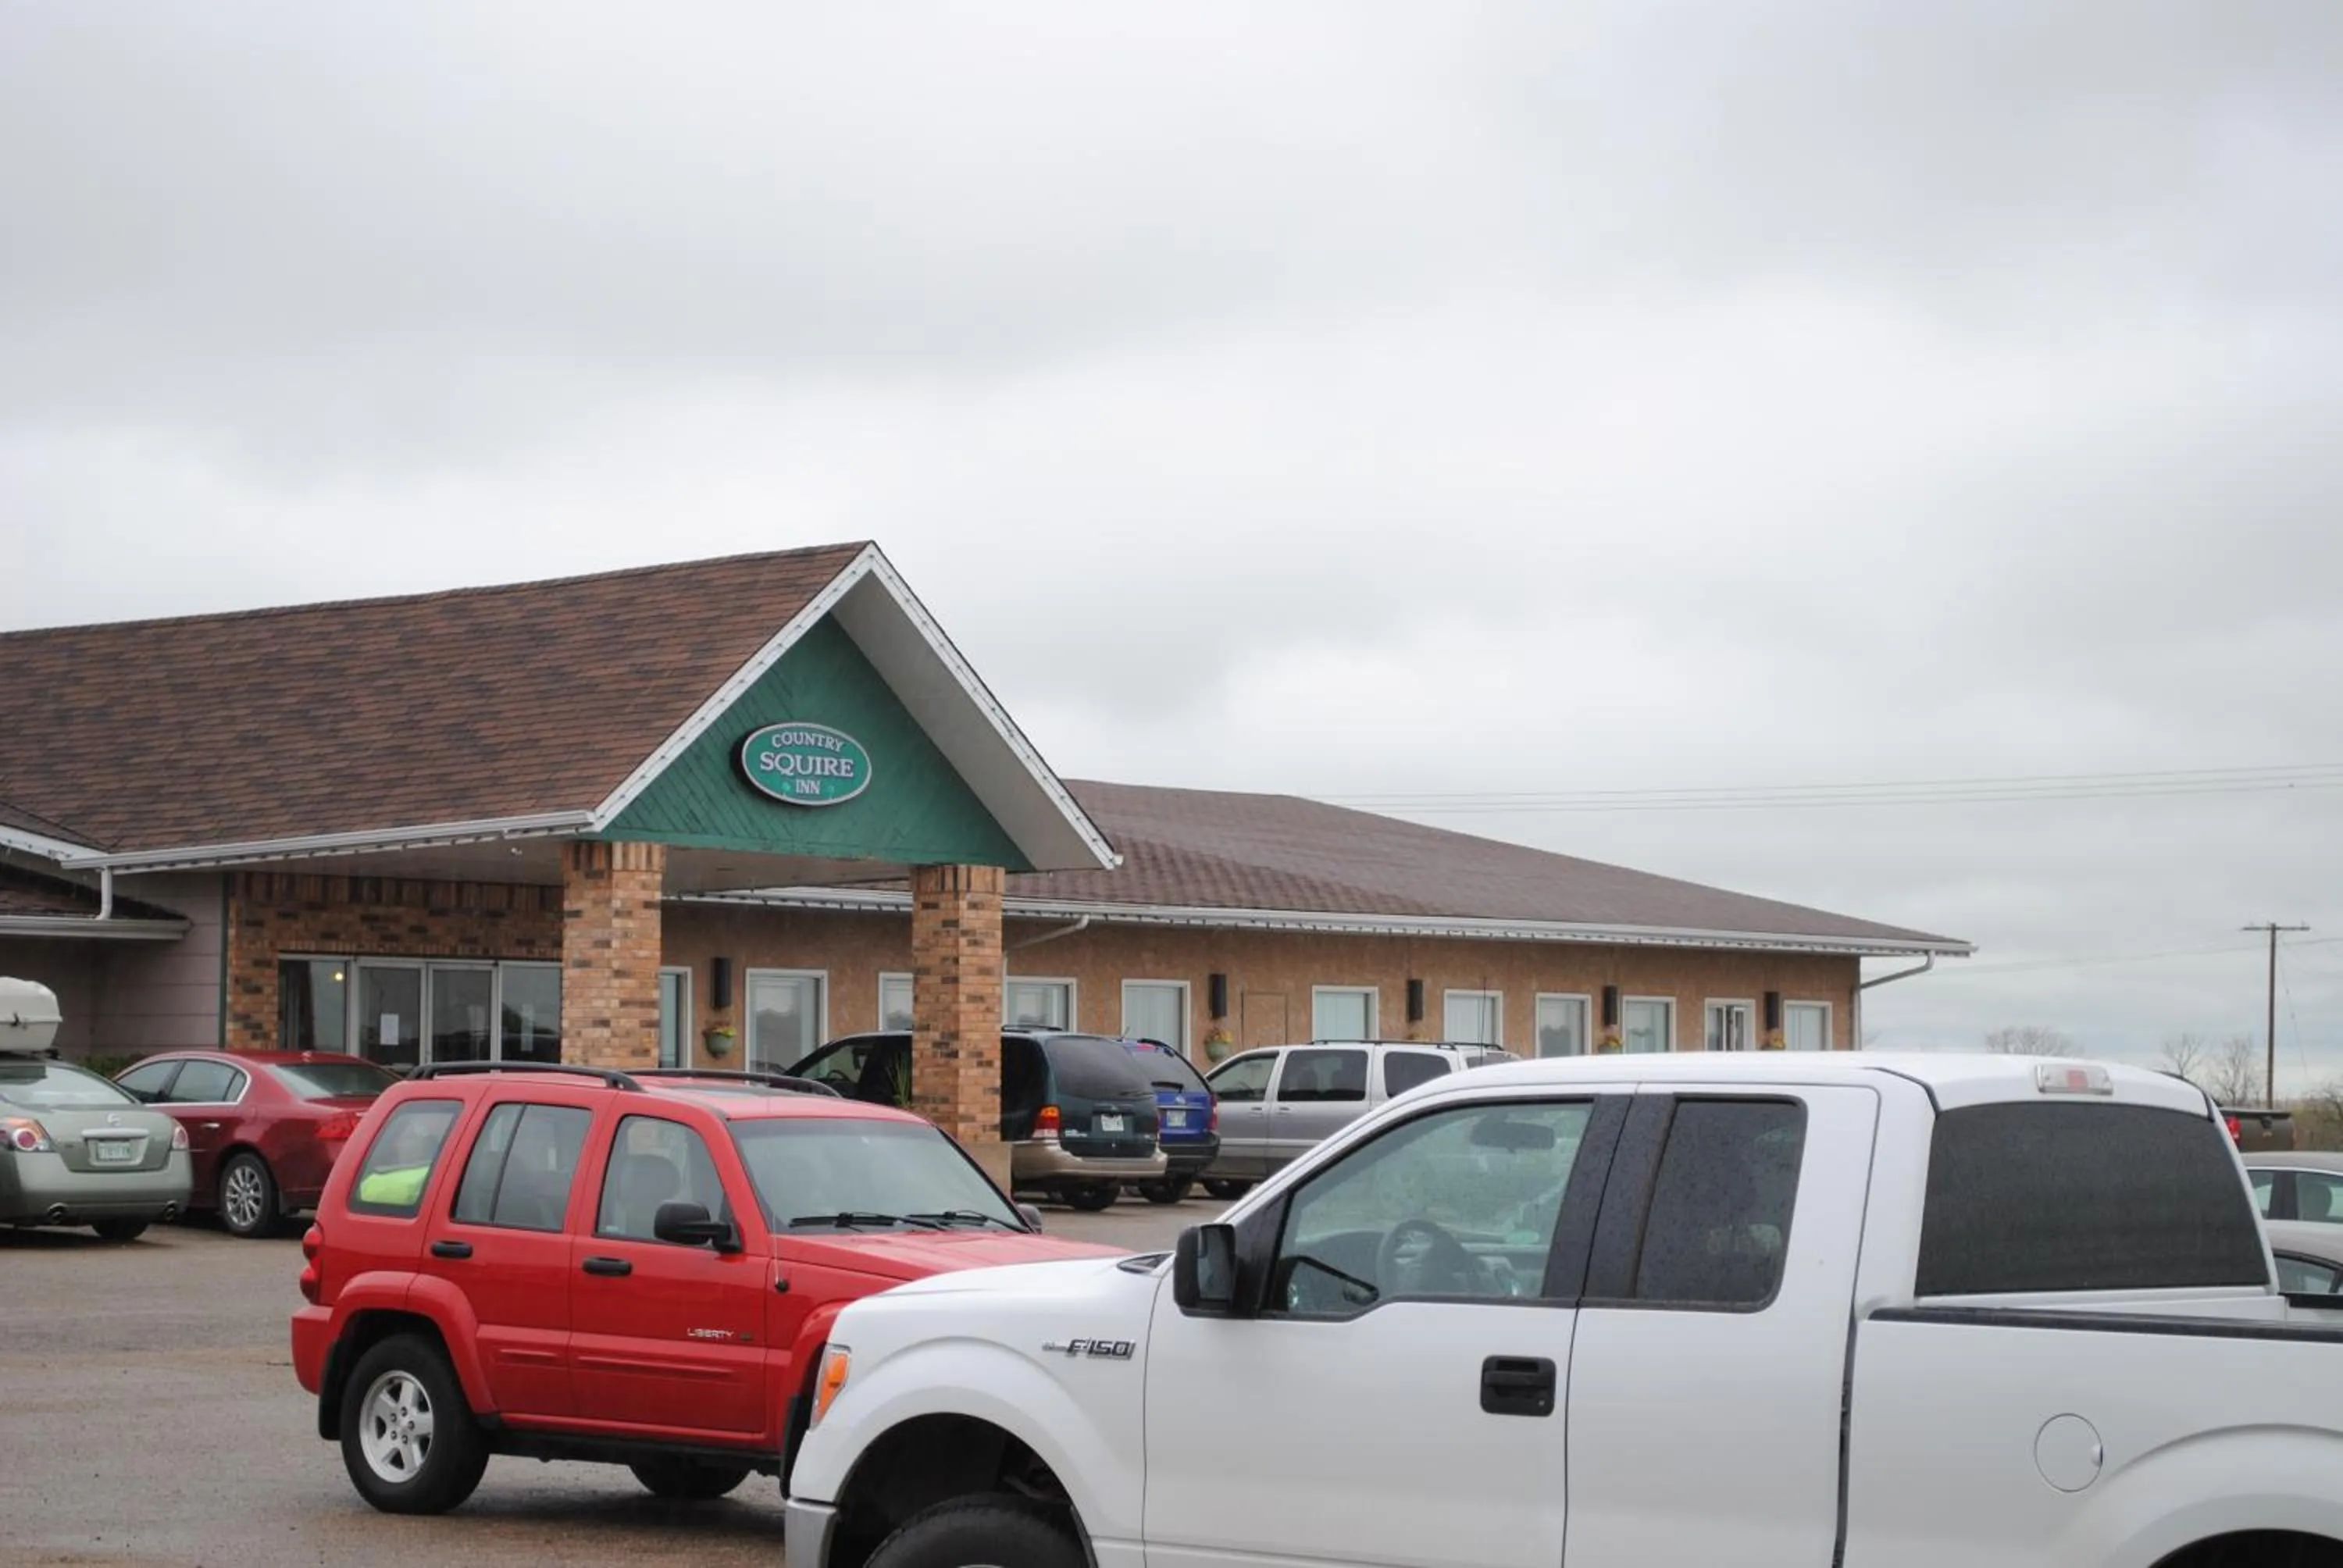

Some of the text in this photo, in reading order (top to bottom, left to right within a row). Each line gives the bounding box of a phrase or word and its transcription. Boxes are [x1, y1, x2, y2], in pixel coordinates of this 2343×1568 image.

[772, 732, 844, 753] COUNTRY
[759, 751, 854, 777] SQUIRE
[796, 779, 820, 795] INN
